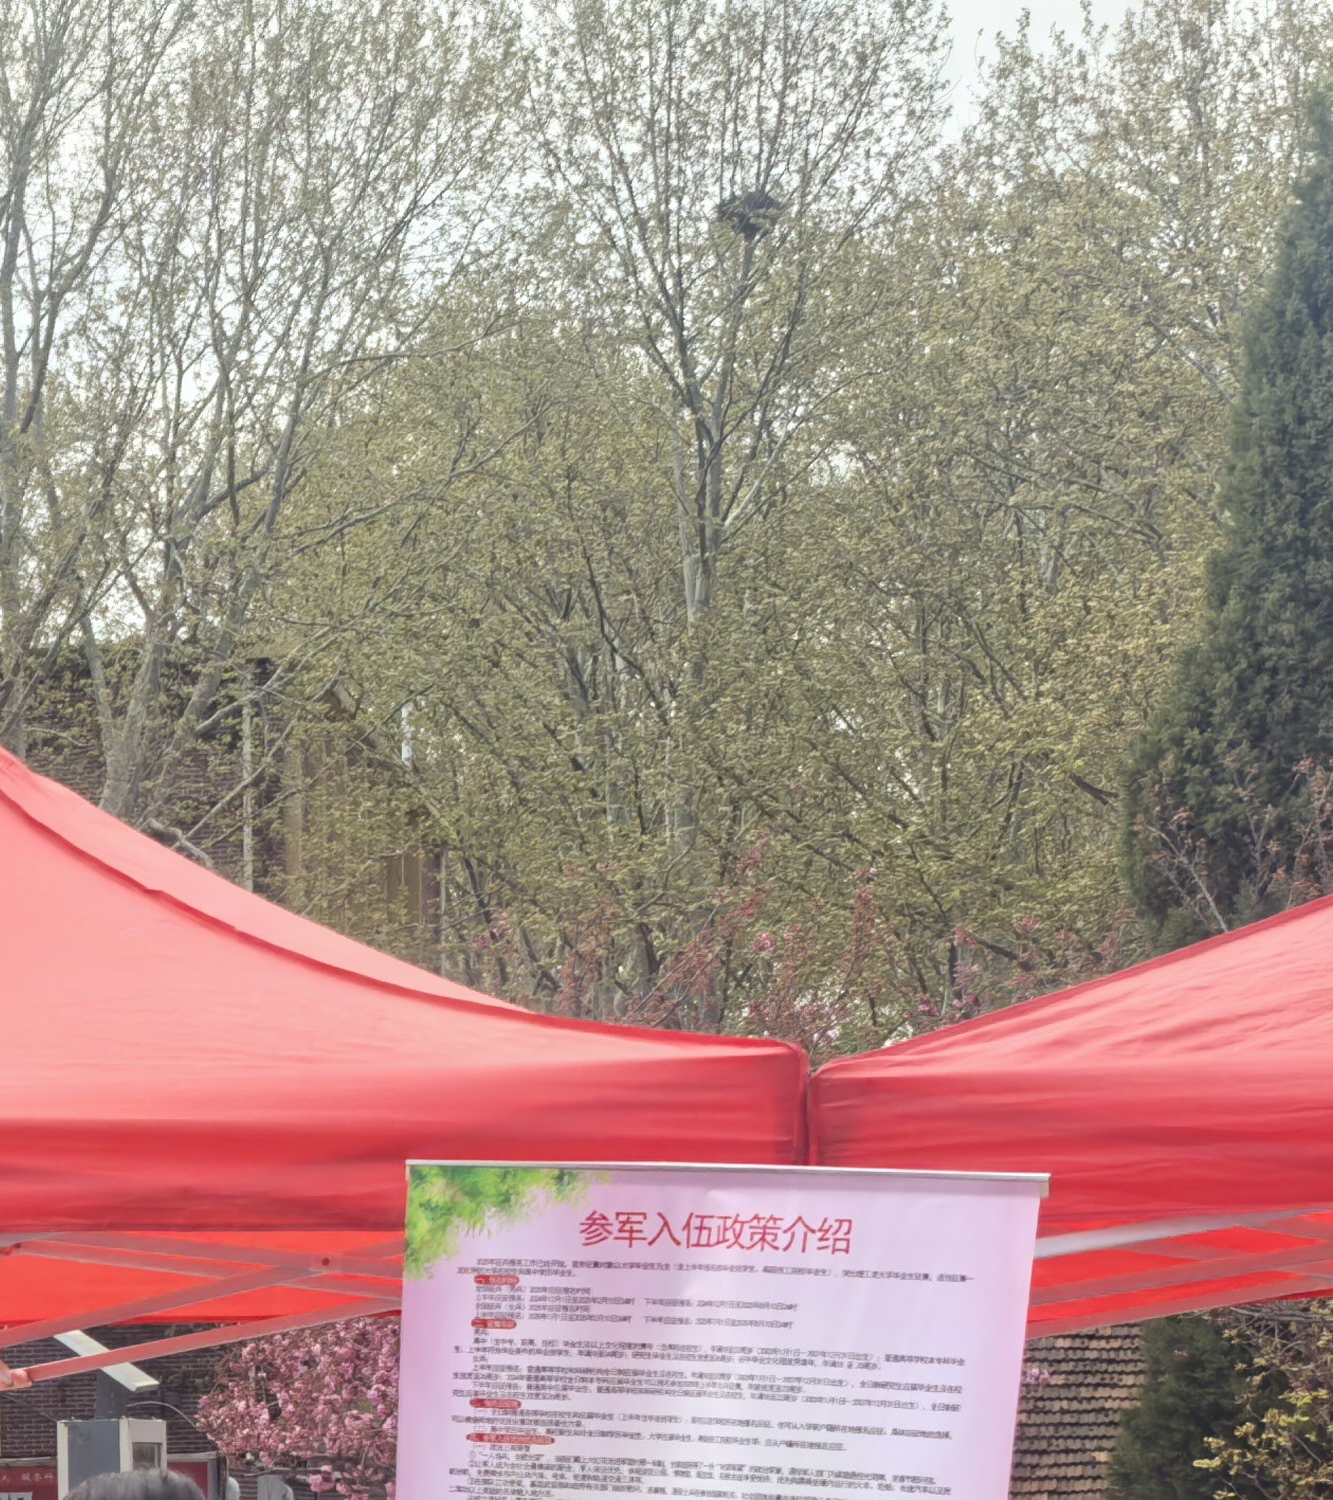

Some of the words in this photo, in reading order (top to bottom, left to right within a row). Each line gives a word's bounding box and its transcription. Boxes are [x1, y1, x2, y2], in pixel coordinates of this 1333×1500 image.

[579, 1209, 853, 1255] 参军入伍政策介绍
